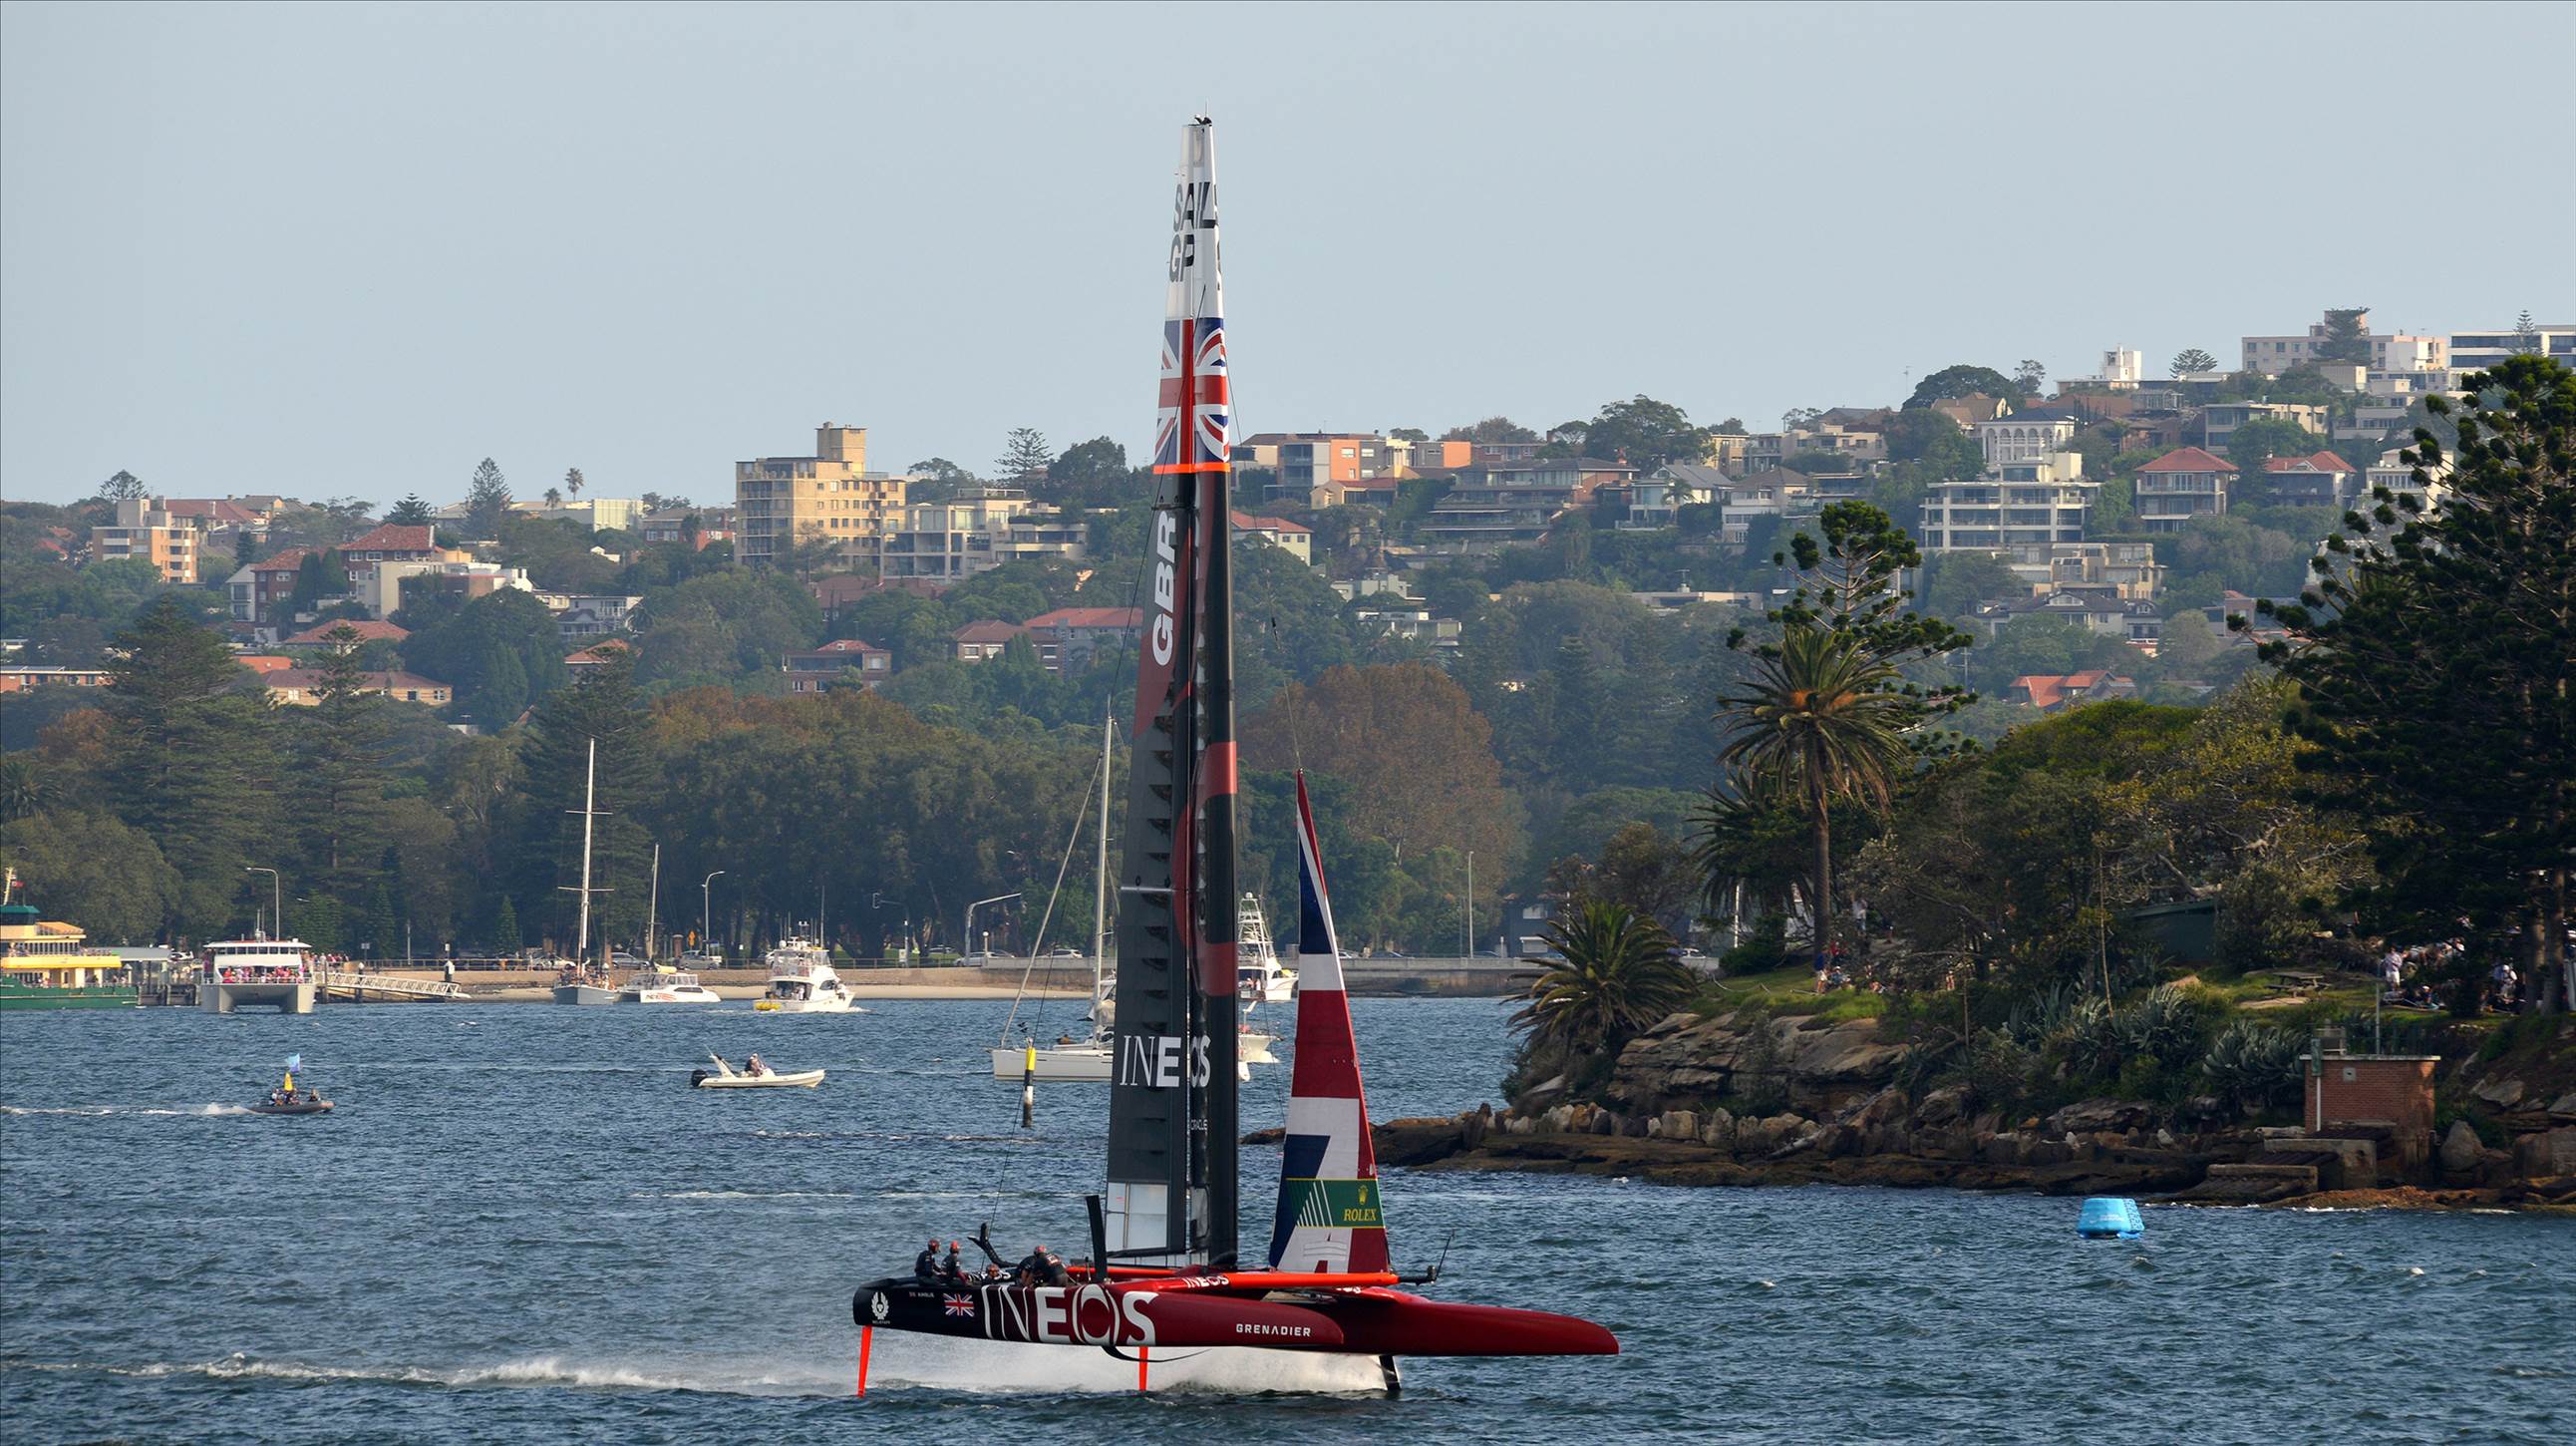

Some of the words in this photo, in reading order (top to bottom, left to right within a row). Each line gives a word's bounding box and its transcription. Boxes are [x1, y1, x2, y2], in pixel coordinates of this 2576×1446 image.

[1173, 181, 1216, 232] SAIL
[1169, 233, 1195, 283] GP
[1152, 510, 1176, 667] GBR
[1120, 1035, 1211, 1088] INEOS
[1343, 1208, 1377, 1222] ROLEX
[1182, 1275, 1229, 1288] INEOS
[981, 1283, 1158, 1345] INEOS
[1236, 1323, 1311, 1337] GRENADIER
